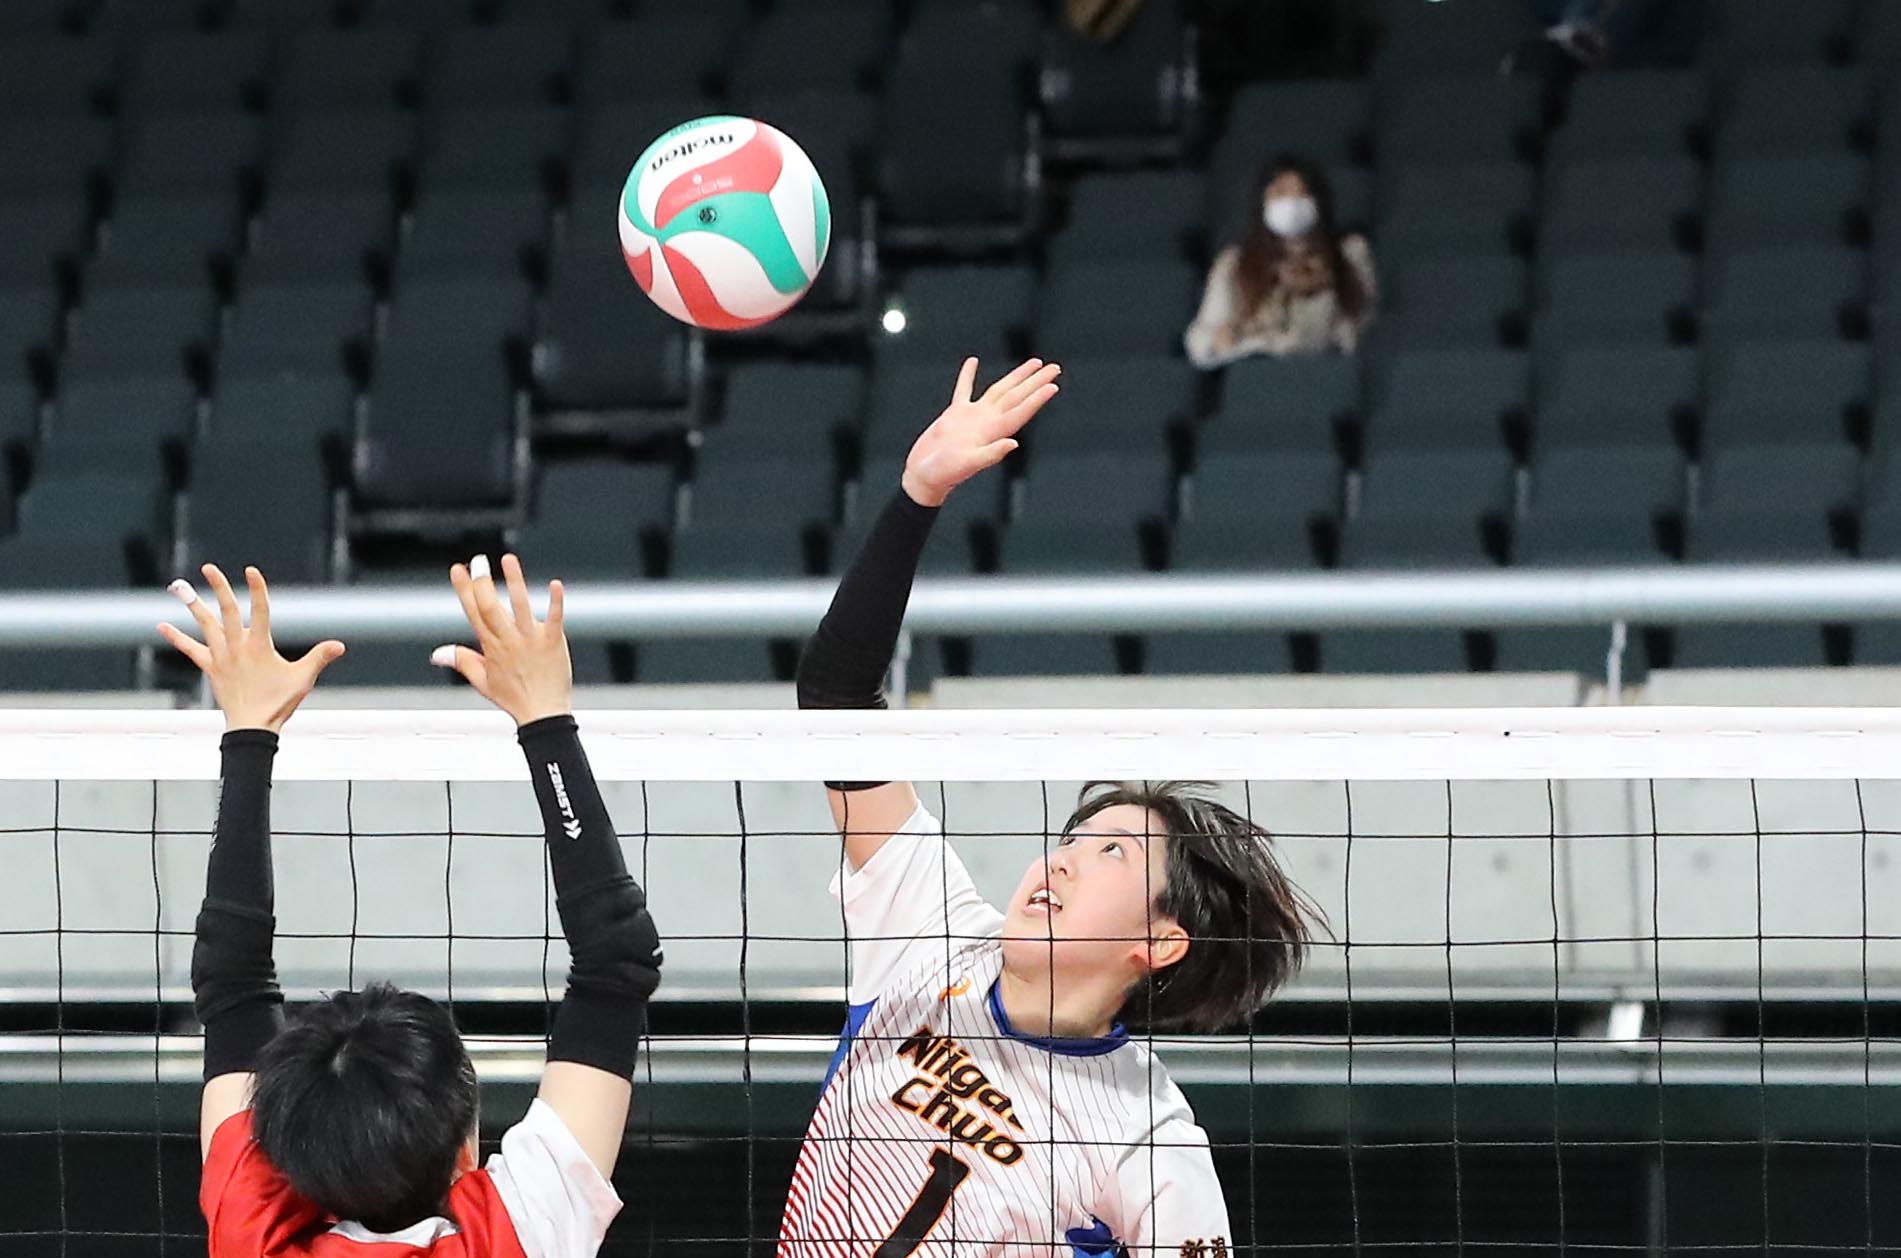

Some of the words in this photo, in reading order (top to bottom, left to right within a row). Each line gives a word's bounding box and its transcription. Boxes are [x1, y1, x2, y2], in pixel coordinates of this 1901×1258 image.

[650, 134, 733, 172] molten
[891, 1076, 1024, 1167] Chuo
[896, 1026, 1025, 1133] Niiga
